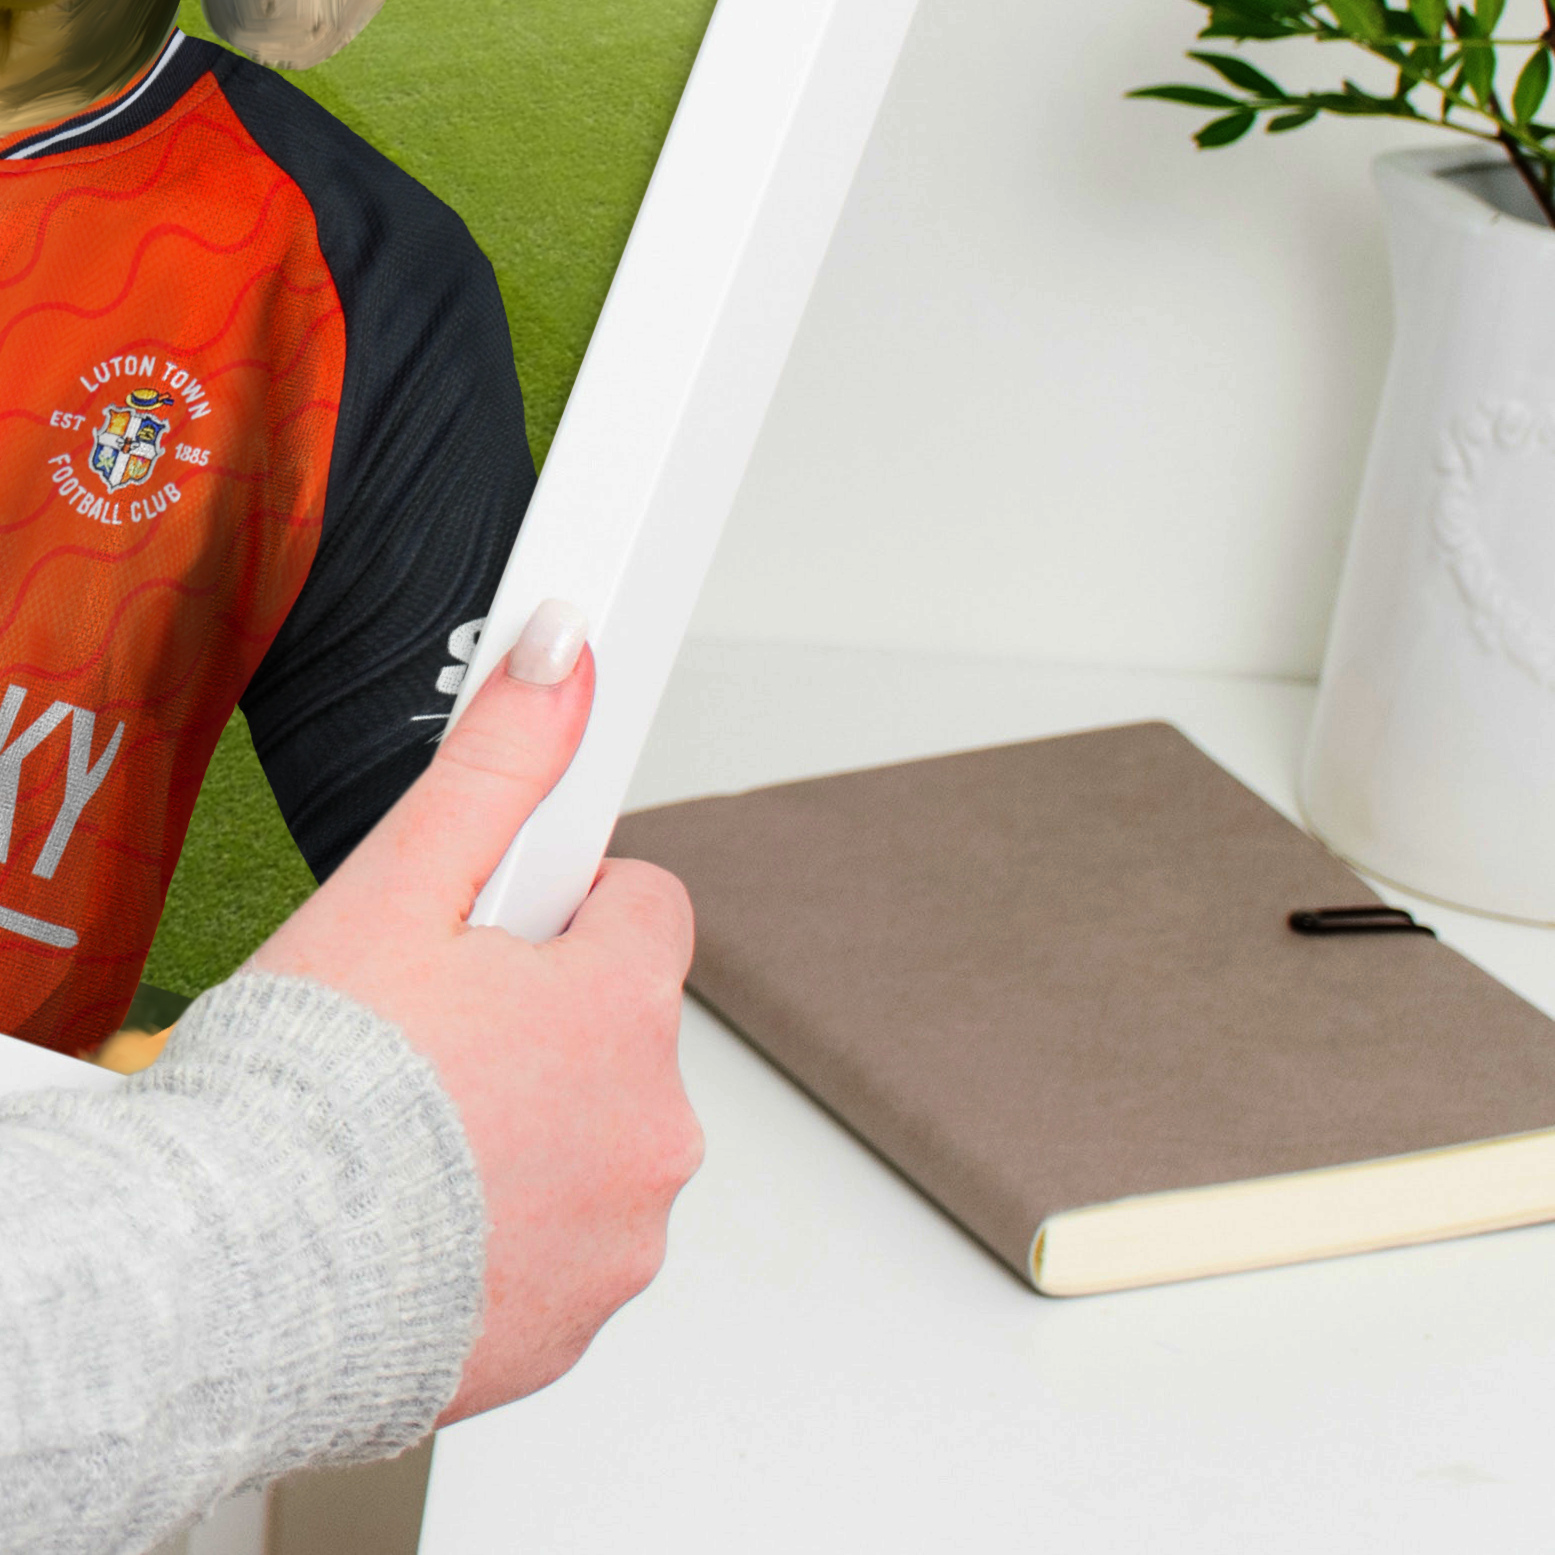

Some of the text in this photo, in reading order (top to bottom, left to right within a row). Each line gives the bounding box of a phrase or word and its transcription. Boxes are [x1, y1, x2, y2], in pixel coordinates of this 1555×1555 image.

[80, 355, 212, 421] LUTON TOWN
[49, 410, 86, 431] EST
[174, 442, 212, 467] 1885
[48, 453, 182, 525] FOOTBALL CLUB
